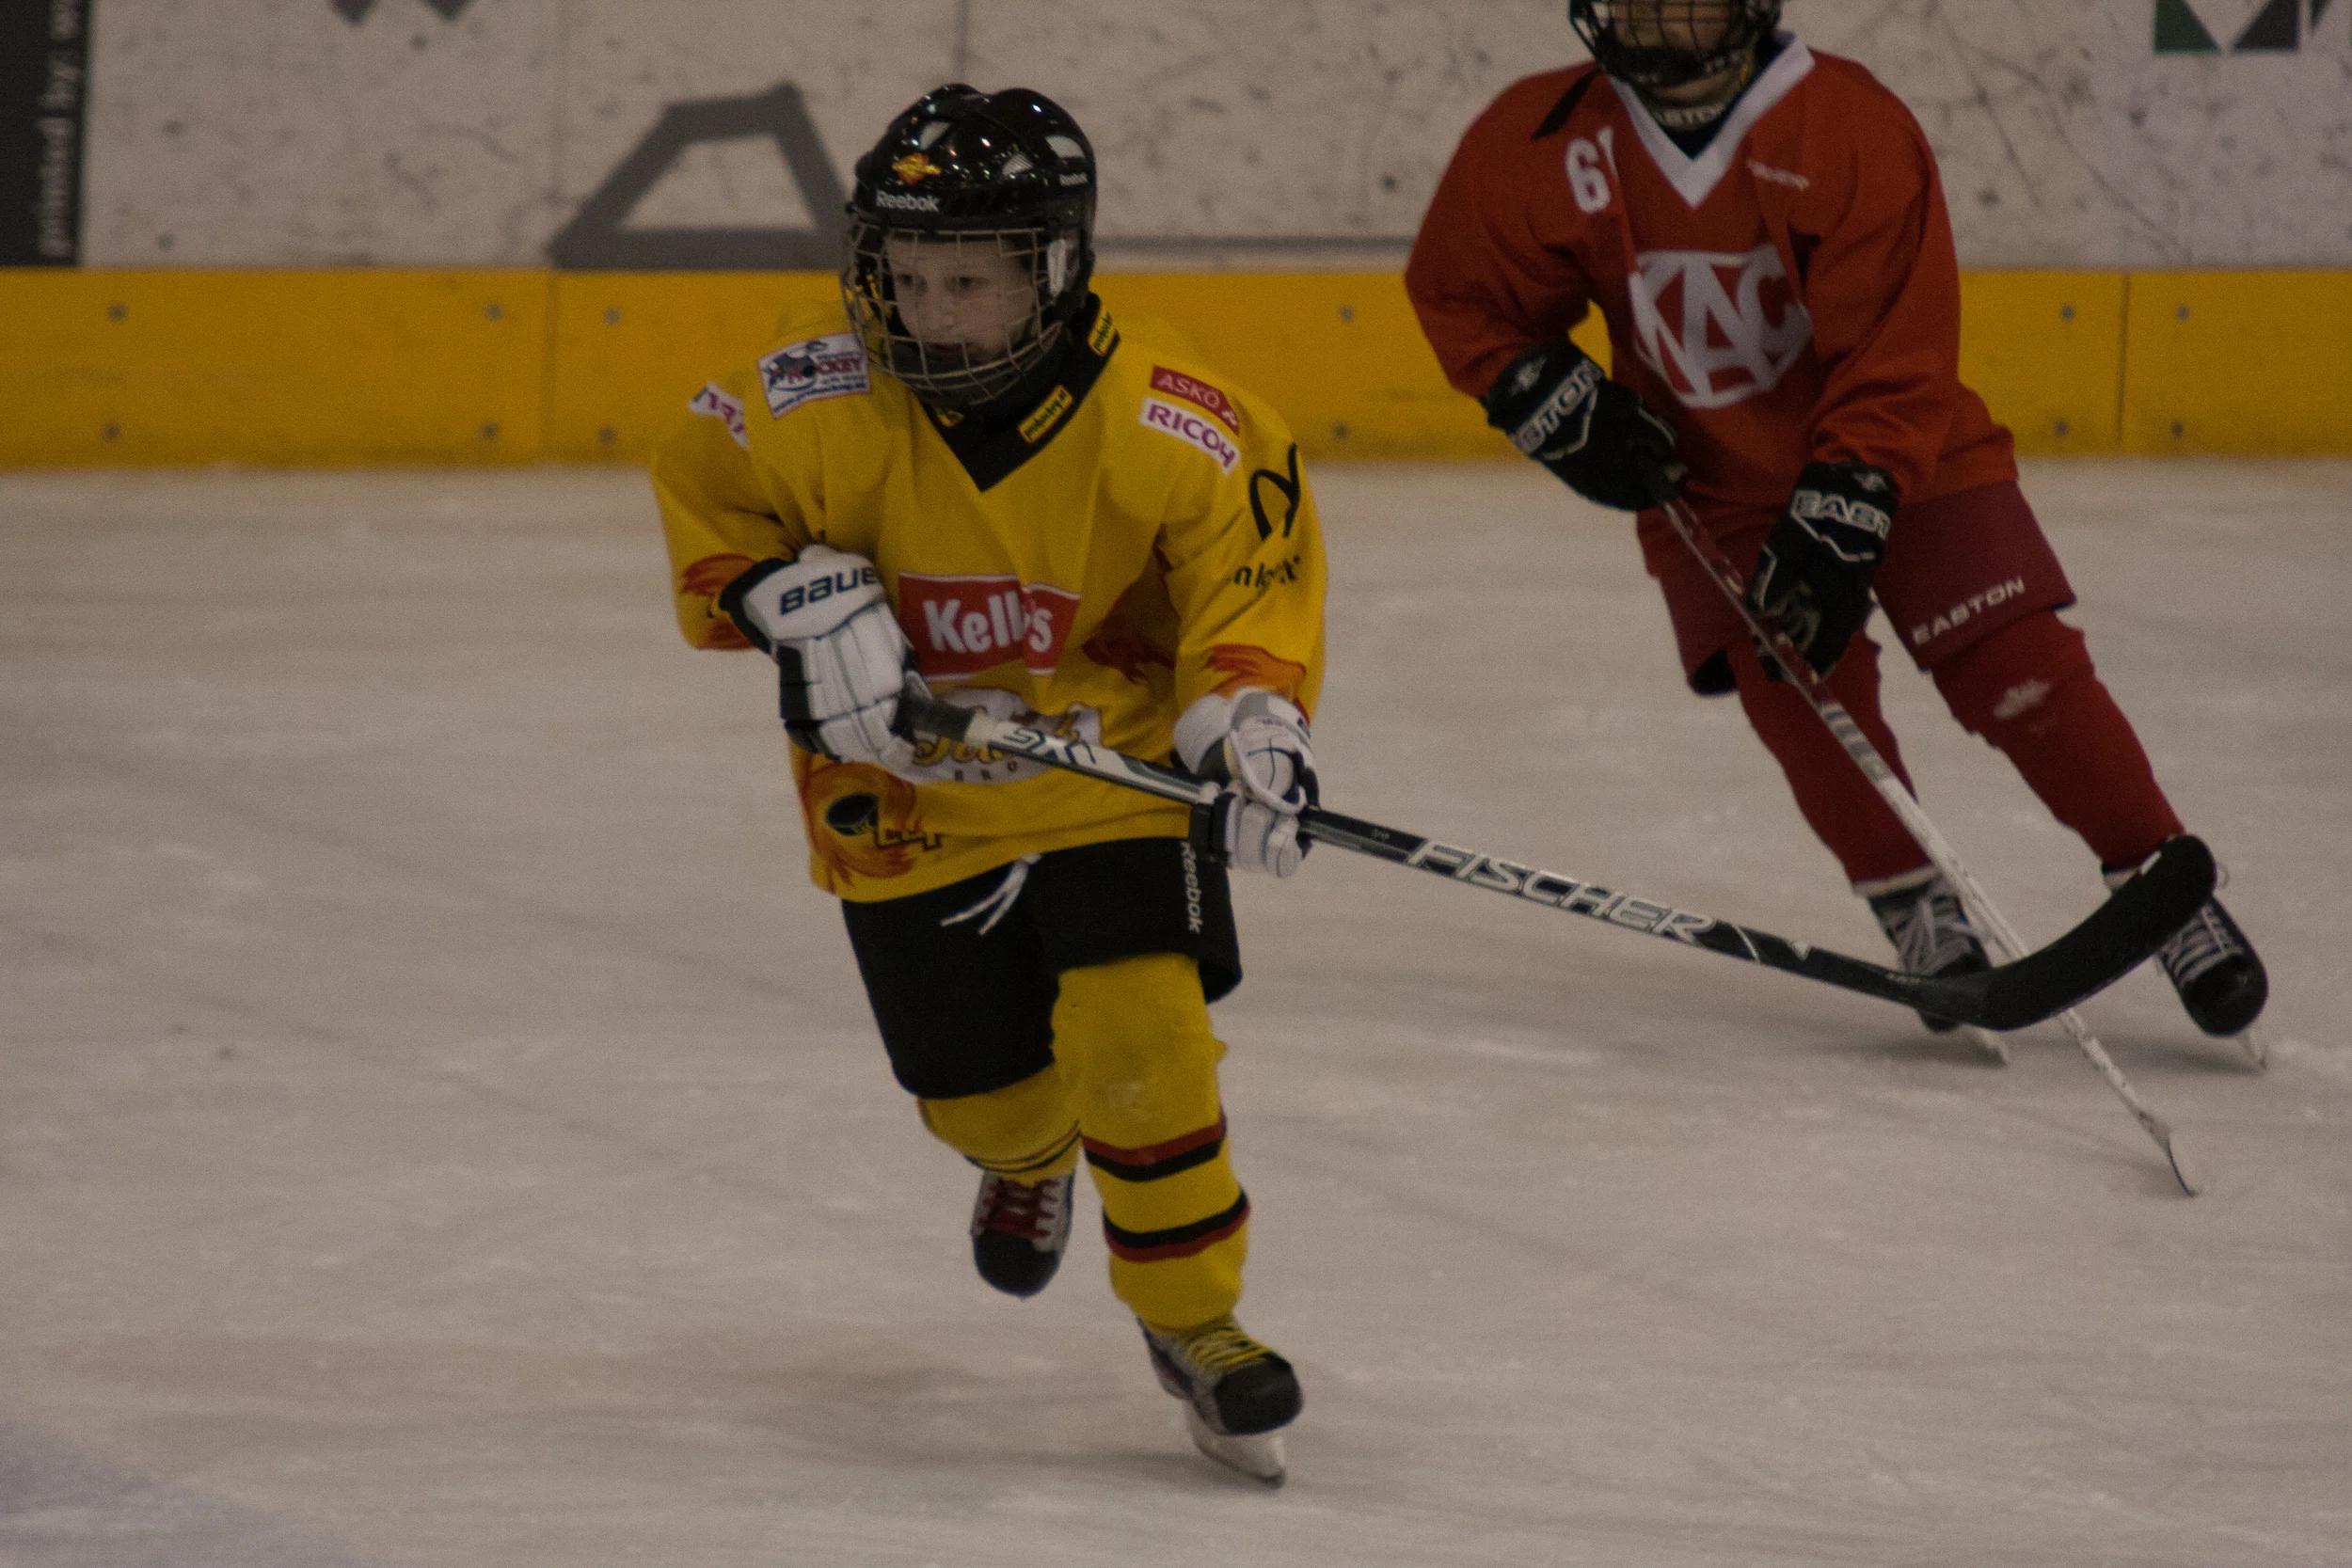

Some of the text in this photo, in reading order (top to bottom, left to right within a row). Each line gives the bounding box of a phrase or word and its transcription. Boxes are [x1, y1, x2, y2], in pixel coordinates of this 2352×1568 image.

[875, 189, 940, 213] Reebok
[1628, 242, 1812, 408] KAC
[1912, 576, 2026, 646] EASTON
[1181, 838, 1210, 934] Reebok
[1409, 837, 1717, 942] FISCHER
